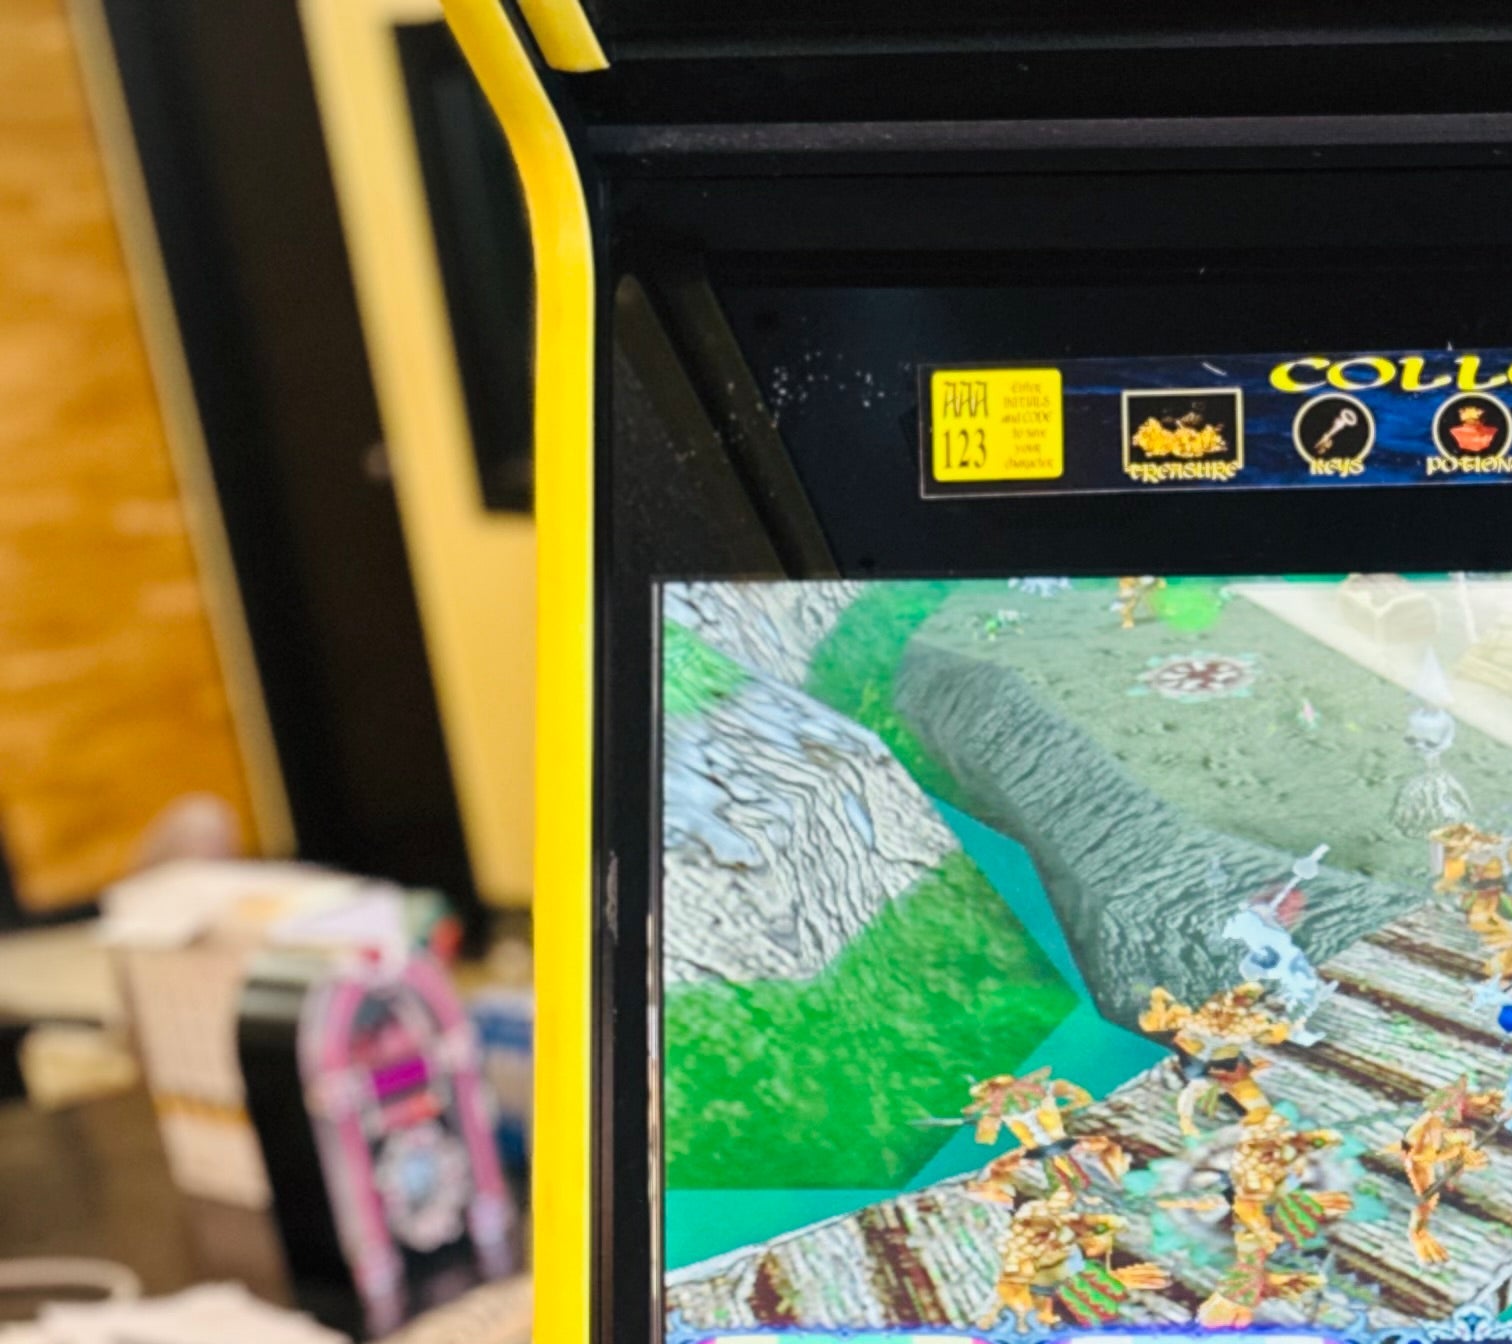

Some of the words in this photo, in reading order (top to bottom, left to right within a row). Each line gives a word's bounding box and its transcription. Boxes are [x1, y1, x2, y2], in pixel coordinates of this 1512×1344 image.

[943, 428, 987, 469] 123
[1127, 460, 1238, 482] TREASURE
[1309, 457, 1365, 476] KEYS
